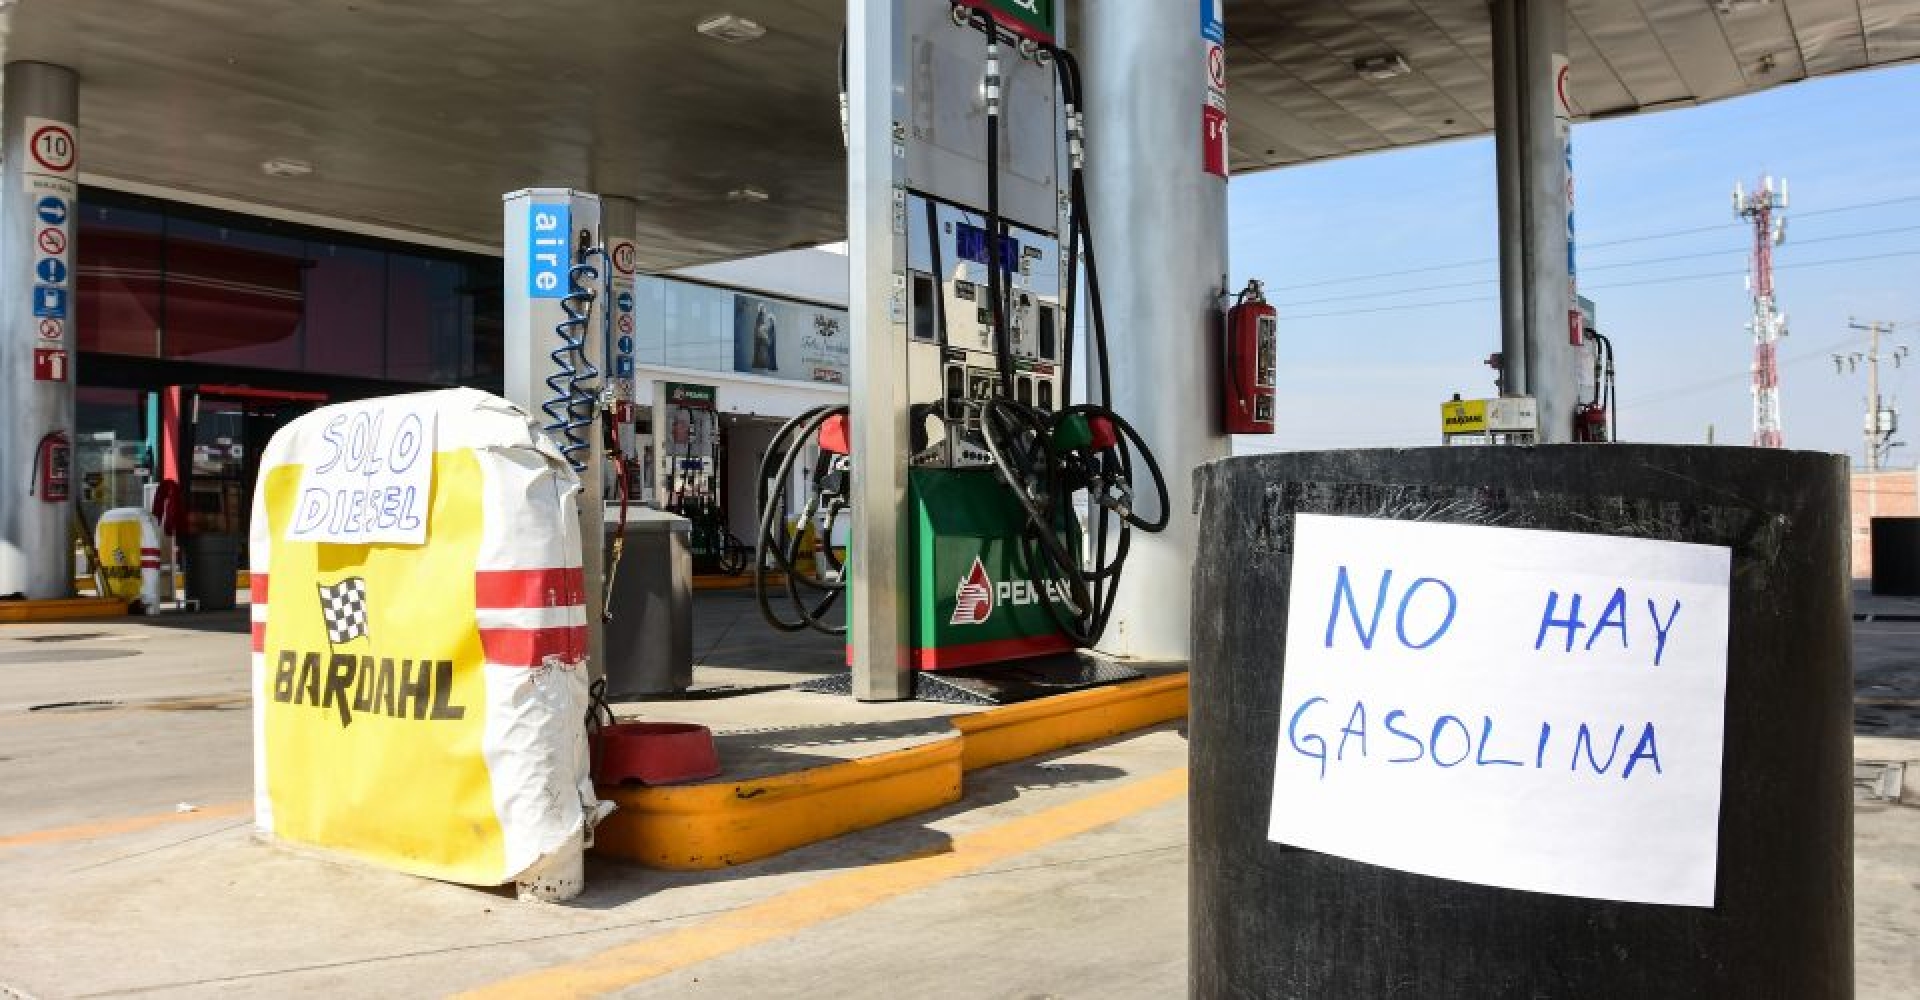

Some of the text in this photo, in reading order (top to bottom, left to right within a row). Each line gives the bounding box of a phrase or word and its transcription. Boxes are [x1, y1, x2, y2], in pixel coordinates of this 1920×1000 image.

[42, 135, 66, 156] 10
[535, 211, 564, 290] aire
[316, 408, 423, 477] SOLO
[294, 485, 421, 535] DIESEL
[1325, 565, 1681, 666] NO HAY
[274, 649, 466, 729] BARDAHL
[1288, 696, 1662, 780] GASOLINA
